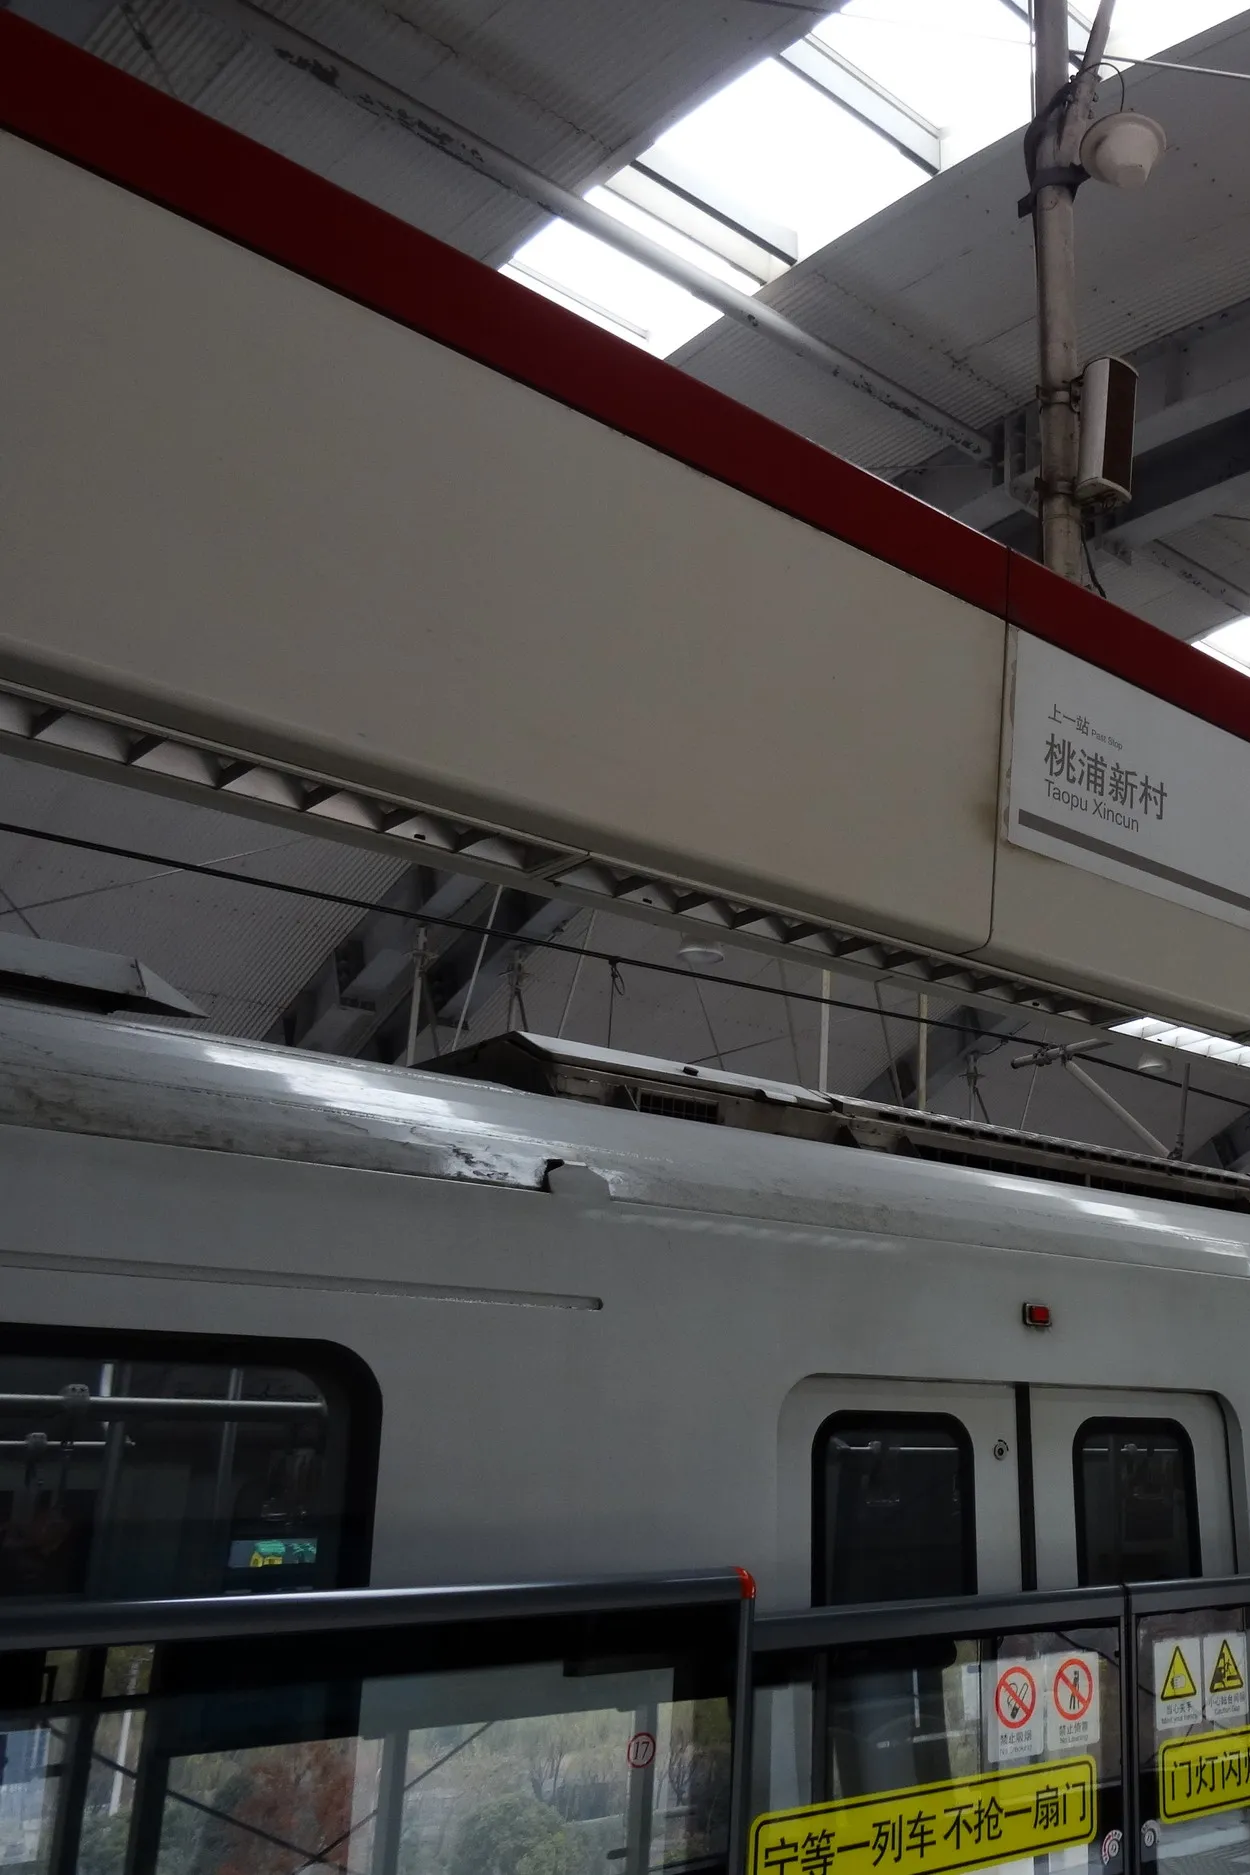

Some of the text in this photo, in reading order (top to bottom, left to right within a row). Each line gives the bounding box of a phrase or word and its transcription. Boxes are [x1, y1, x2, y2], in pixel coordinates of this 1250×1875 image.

[1048, 704, 1090, 736] 上一站
[1108, 736, 1123, 751] Stop
[1044, 733, 1167, 820] 桃浦新村
[1045, 778, 1139, 832] Taopu Xincun
[635, 1741, 650, 1760] 17
